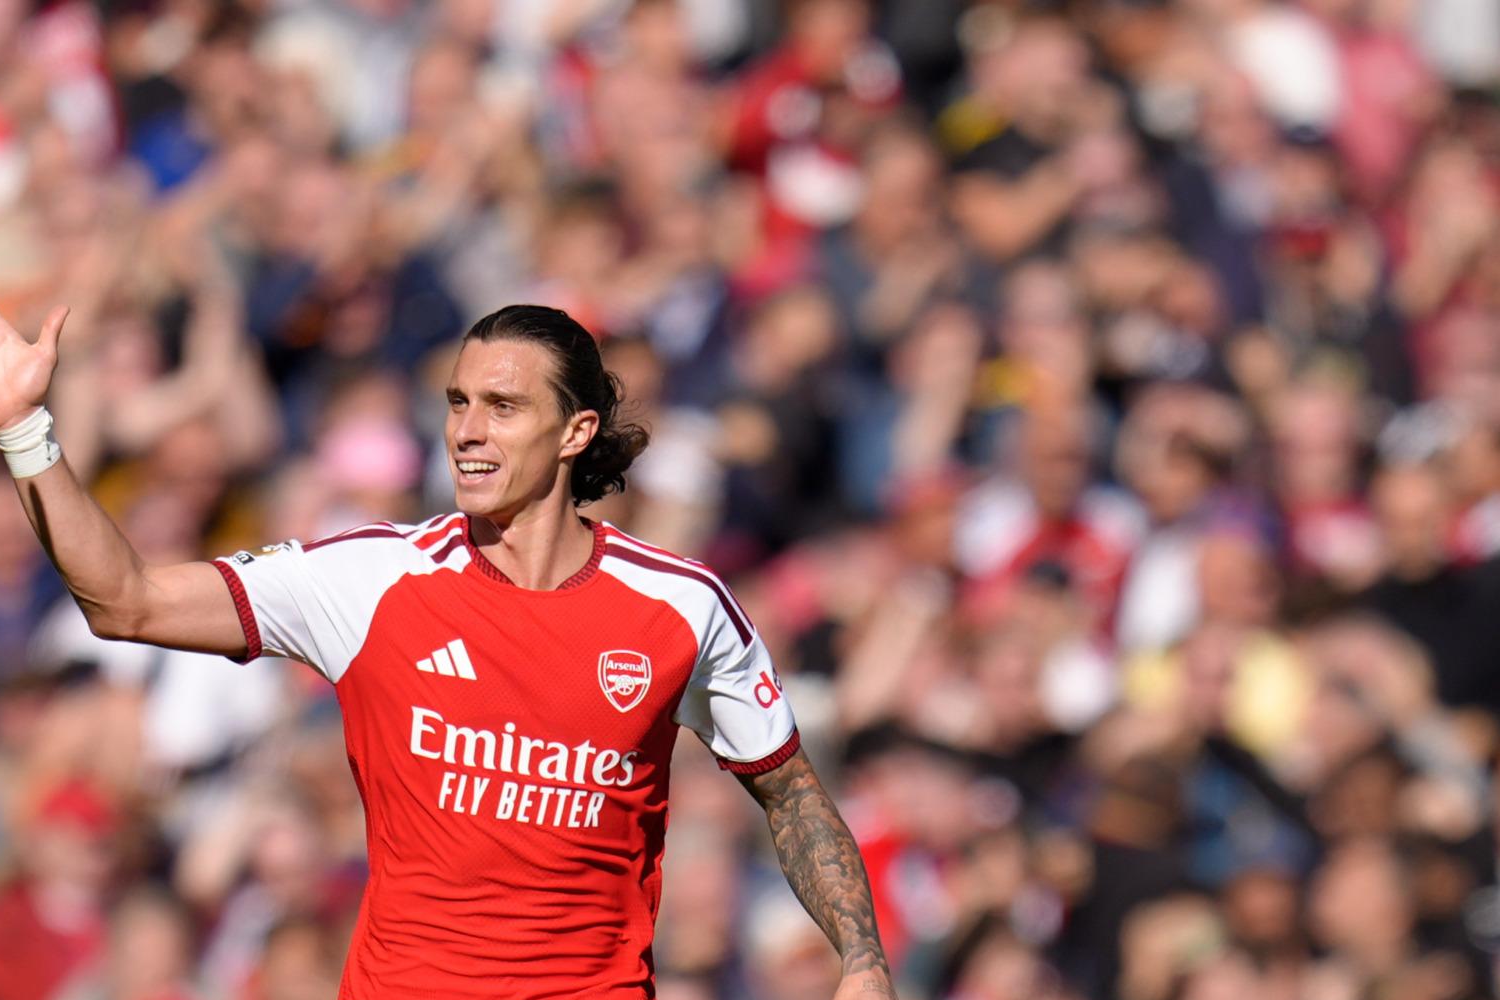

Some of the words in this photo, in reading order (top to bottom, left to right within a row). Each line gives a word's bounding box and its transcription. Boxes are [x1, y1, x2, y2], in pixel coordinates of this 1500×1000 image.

[606, 659, 645, 673] Arsenal
[410, 705, 638, 787] Emirates
[438, 771, 491, 816] FLY
[495, 780, 606, 829] BETTER
